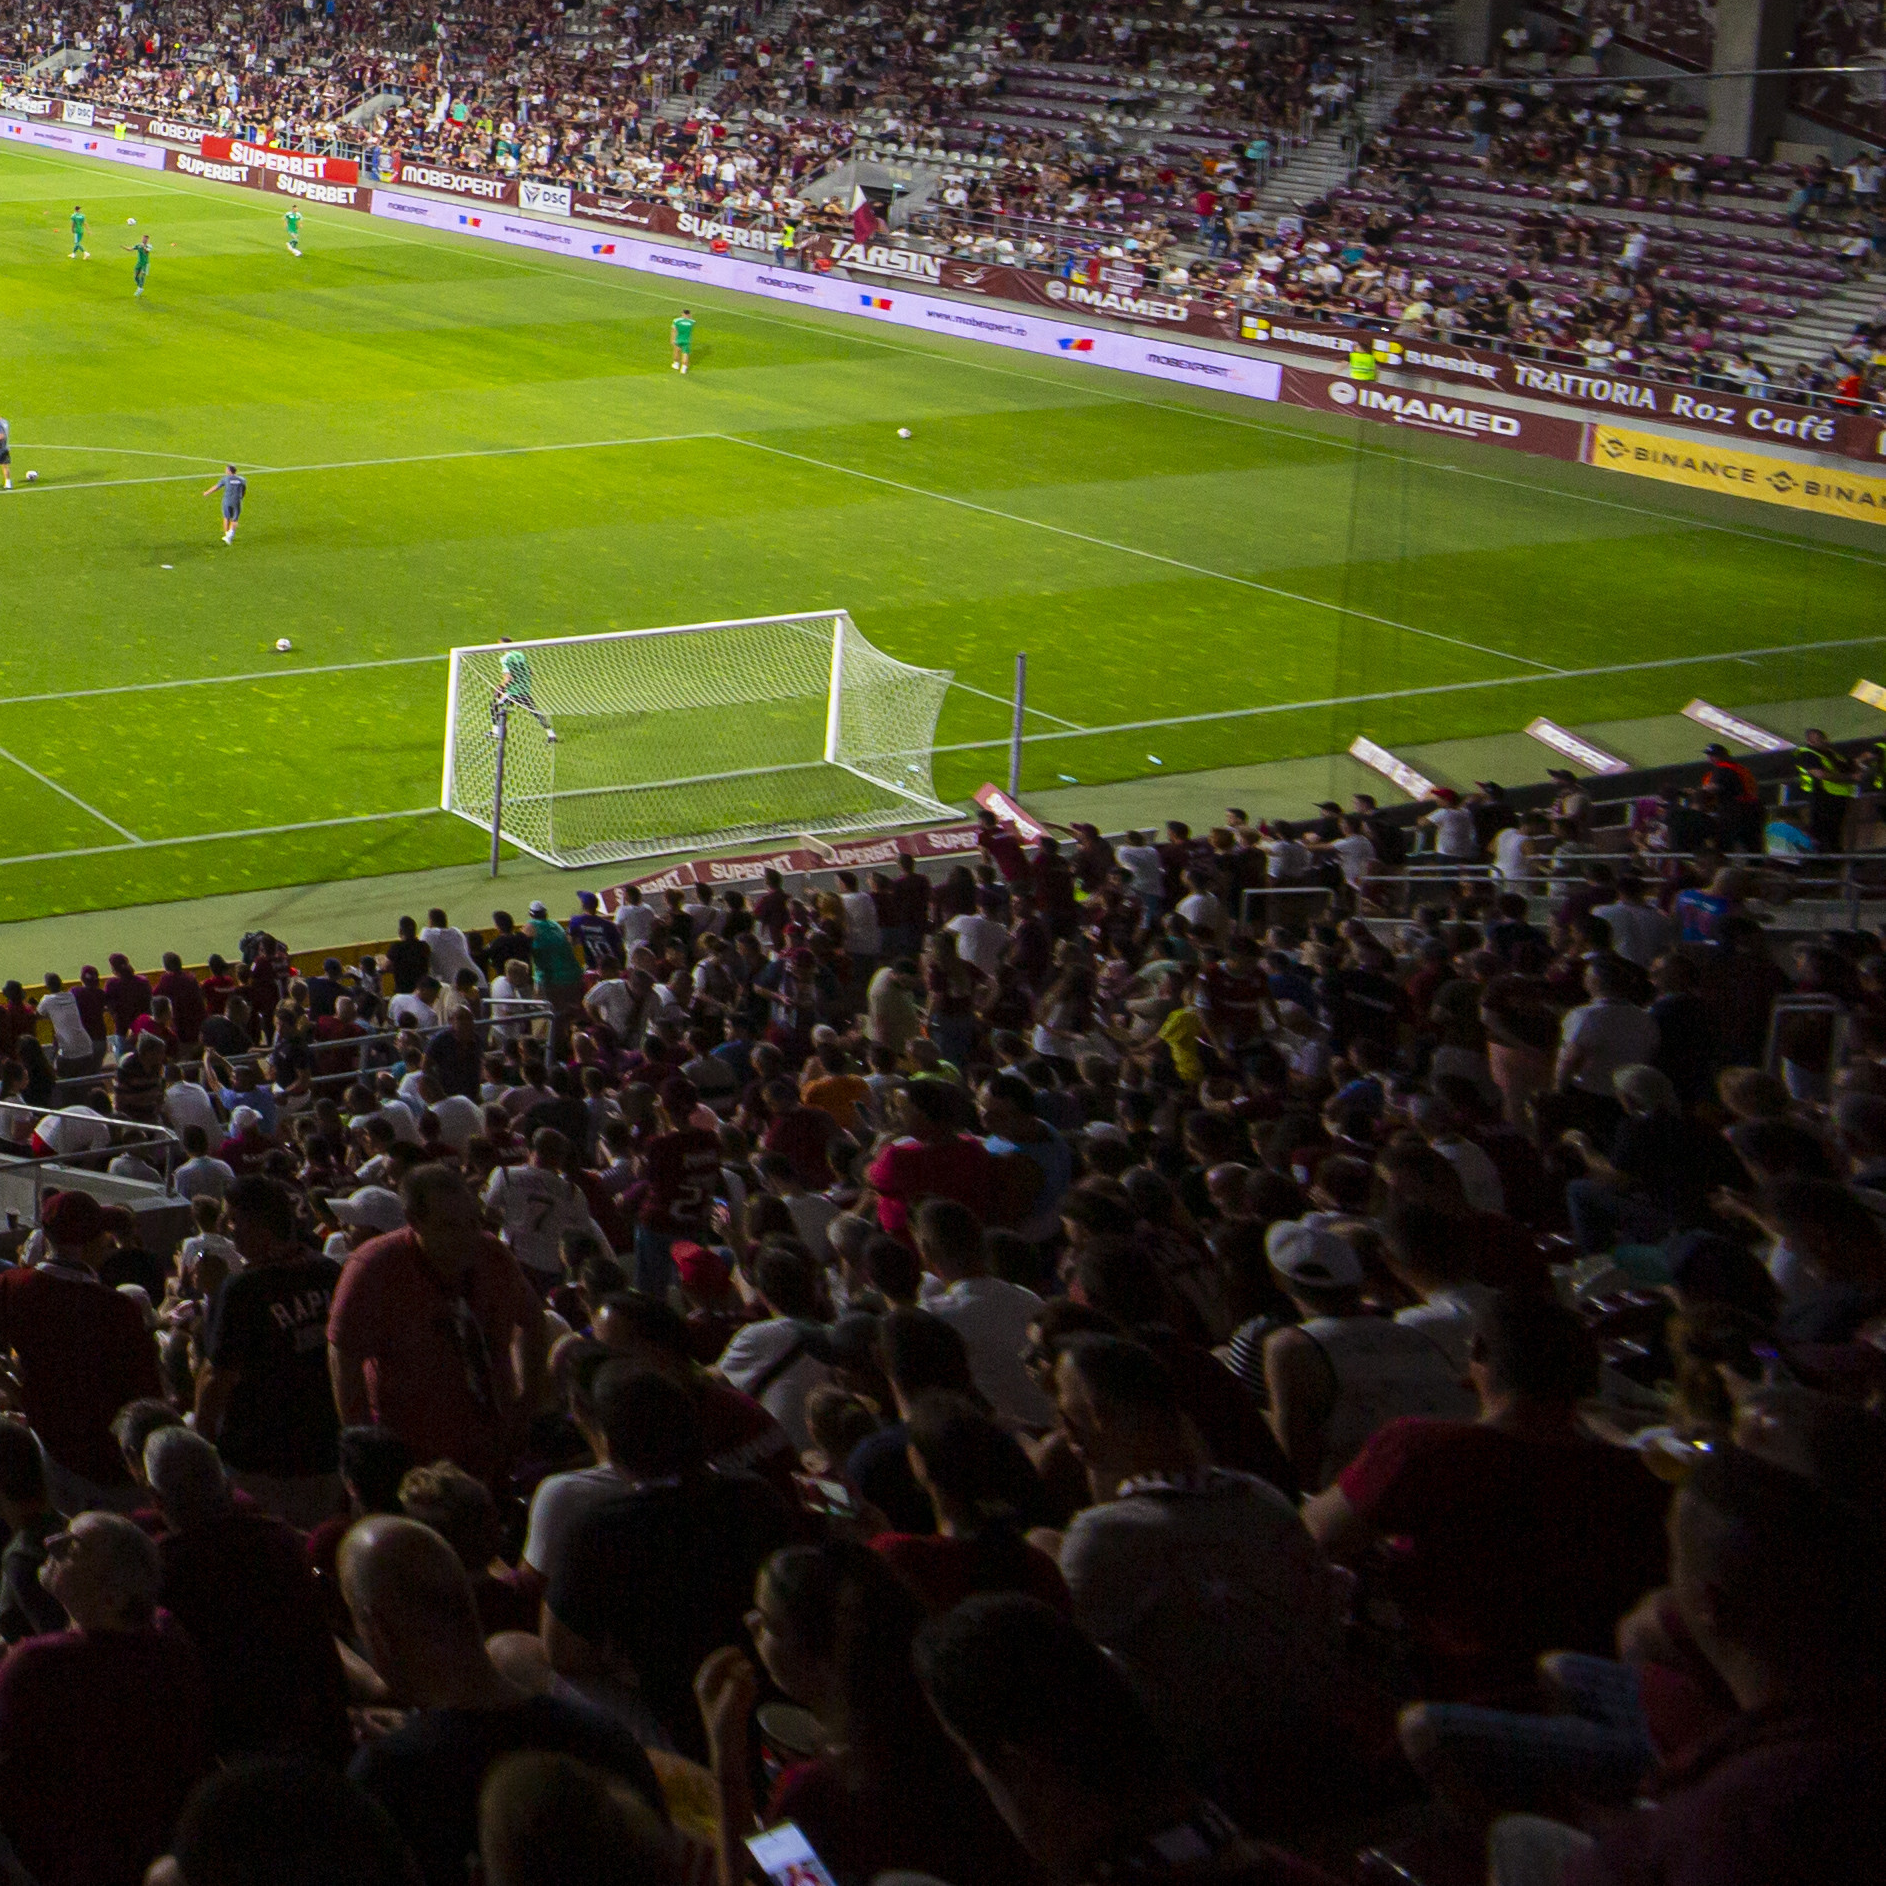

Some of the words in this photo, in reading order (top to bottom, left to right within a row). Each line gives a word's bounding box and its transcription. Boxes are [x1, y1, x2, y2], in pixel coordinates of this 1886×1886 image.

[176, 153, 249, 183] SUPERBET
[229, 141, 327, 179] SUPERBET
[276, 173, 358, 205] SUPERBET
[401, 164, 506, 200] MOBEXPERT
[542, 190, 567, 206] DSC
[387, 202, 428, 216] MOBEXPERT
[504, 225, 572, 245] www.mobexpert.ro
[675, 212, 785, 252] SUPERBE
[649, 254, 704, 272] MOBEXPERT
[829, 238, 949, 277] TARSIN
[756, 275, 816, 294] MOBEXPERT
[1067, 287, 1189, 322] IMAMED
[926, 309, 1028, 336] www.mobexpert.ro
[1146, 352, 1232, 379] MOBEXPERT
[1404, 350, 1501, 381] BARRIER
[1358, 388, 1521, 438] IMAMED
[1514, 363, 1658, 411] TRATTORIA
[1670, 393, 1735, 426] Roz
[1746, 409, 1837, 443] Café
[1633, 446, 1757, 485] BINANCE
[1803, 480, 1886, 510] BINA
[527, 1194, 555, 1232] 7
[269, 1290, 331, 1331] RAPI
